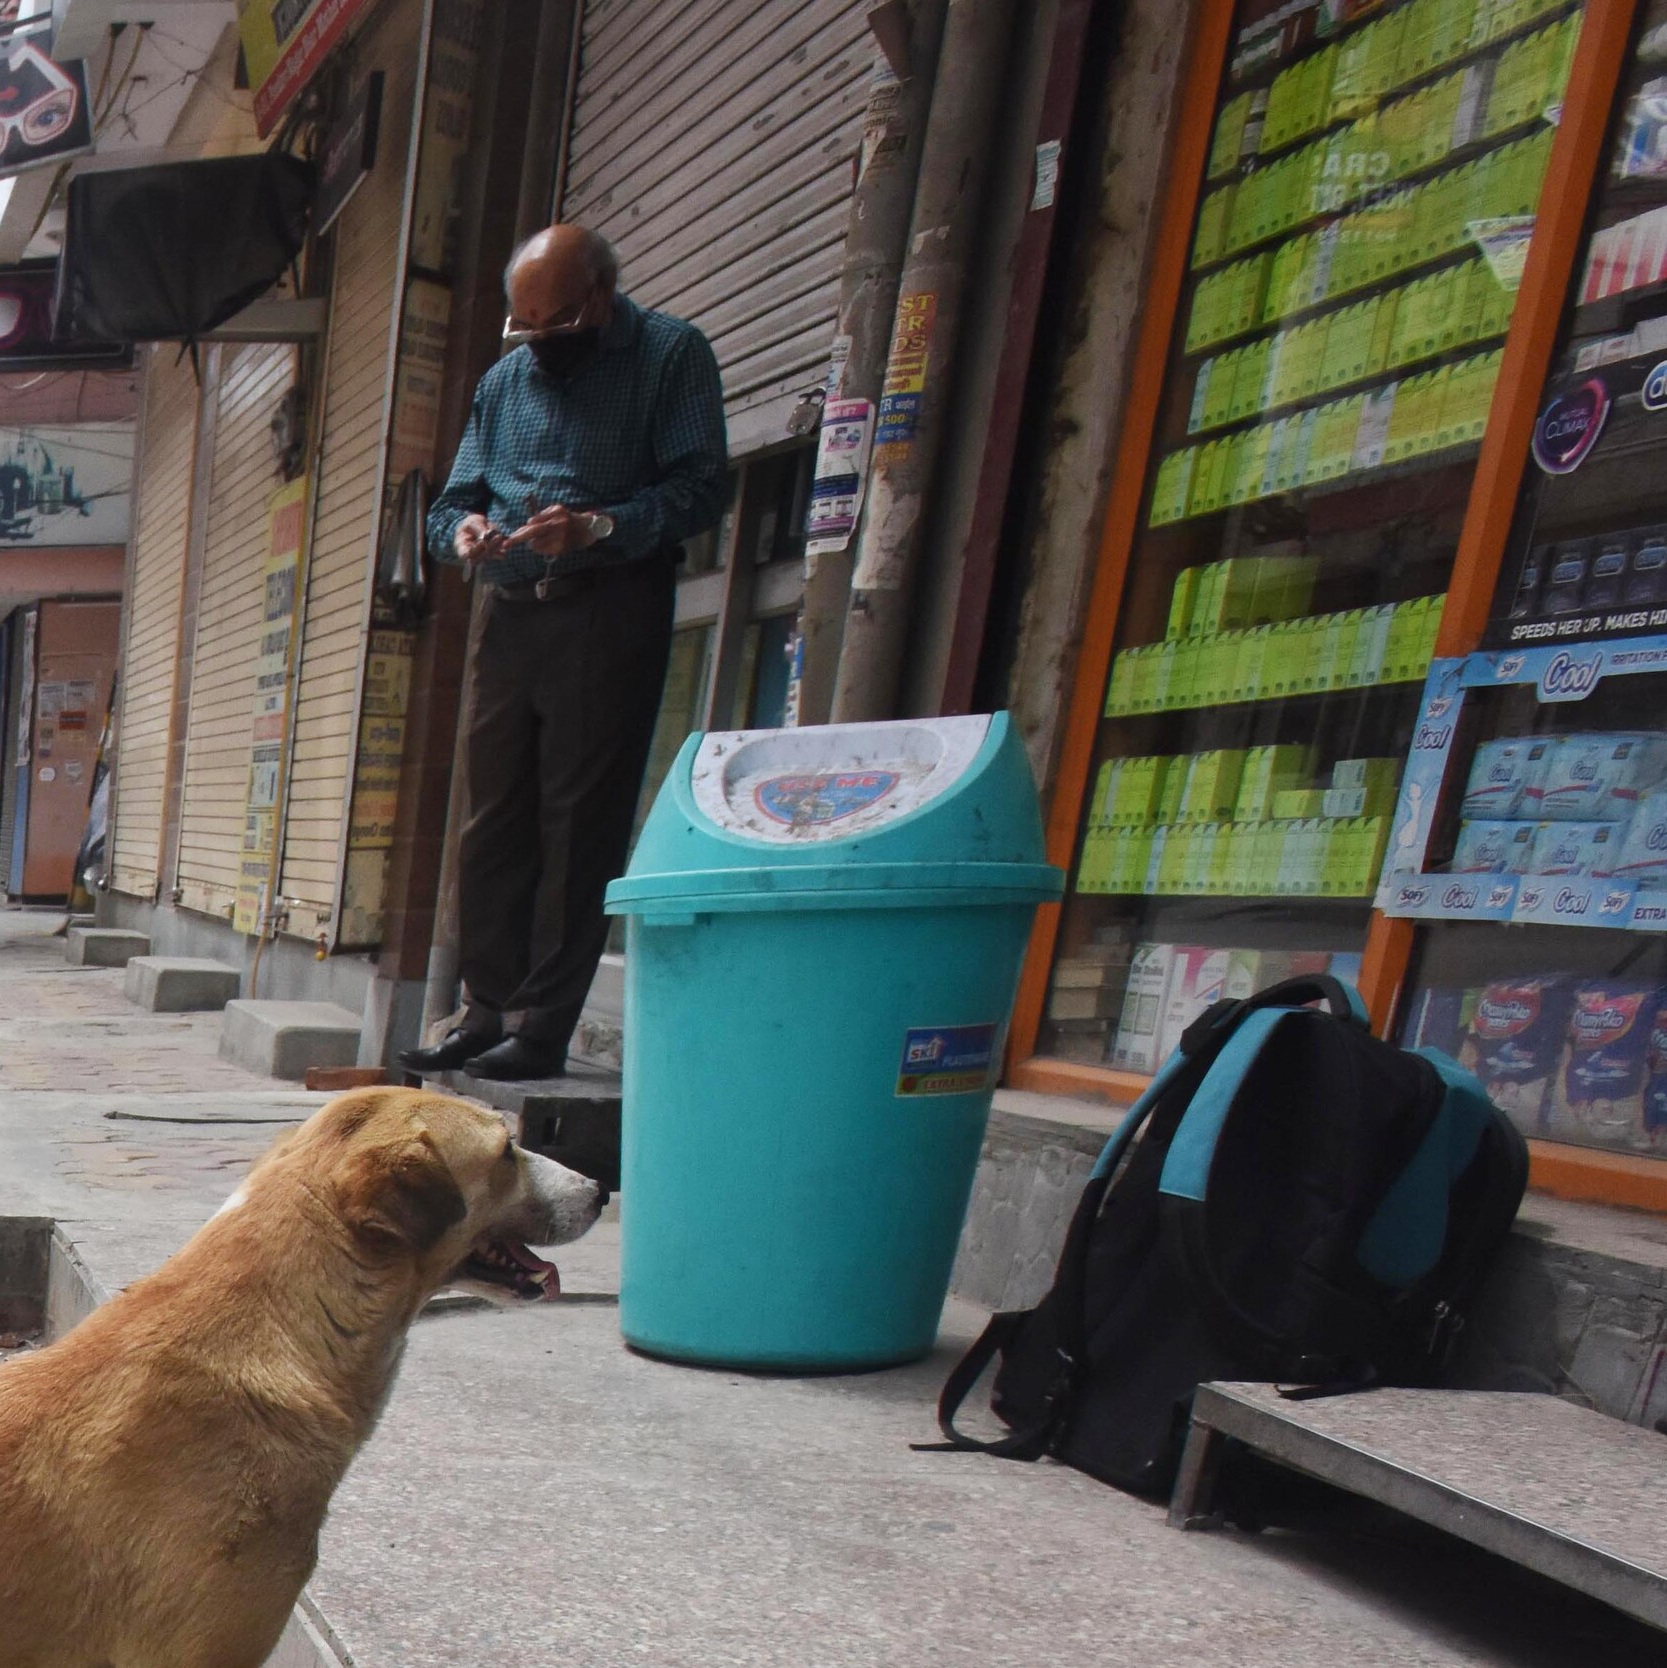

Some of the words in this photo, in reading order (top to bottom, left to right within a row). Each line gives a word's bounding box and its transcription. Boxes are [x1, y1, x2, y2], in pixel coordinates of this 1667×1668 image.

[1510, 620, 1557, 640] SPEEDS
[1556, 618, 1582, 635] HER
[1583, 617, 1602, 633] UP.
[1605, 611, 1650, 630] MAKES
[1649, 608, 1667, 625] HI
[1543, 650, 1604, 695] Cool
[1610, 651, 1660, 666] IRRITATION
[1414, 724, 1451, 750] Cool
[836, 776, 879, 788] ME
[1441, 884, 1478, 910] Cool
[1553, 887, 1591, 915] Cool
[1634, 907, 1667, 921] EXTRA
